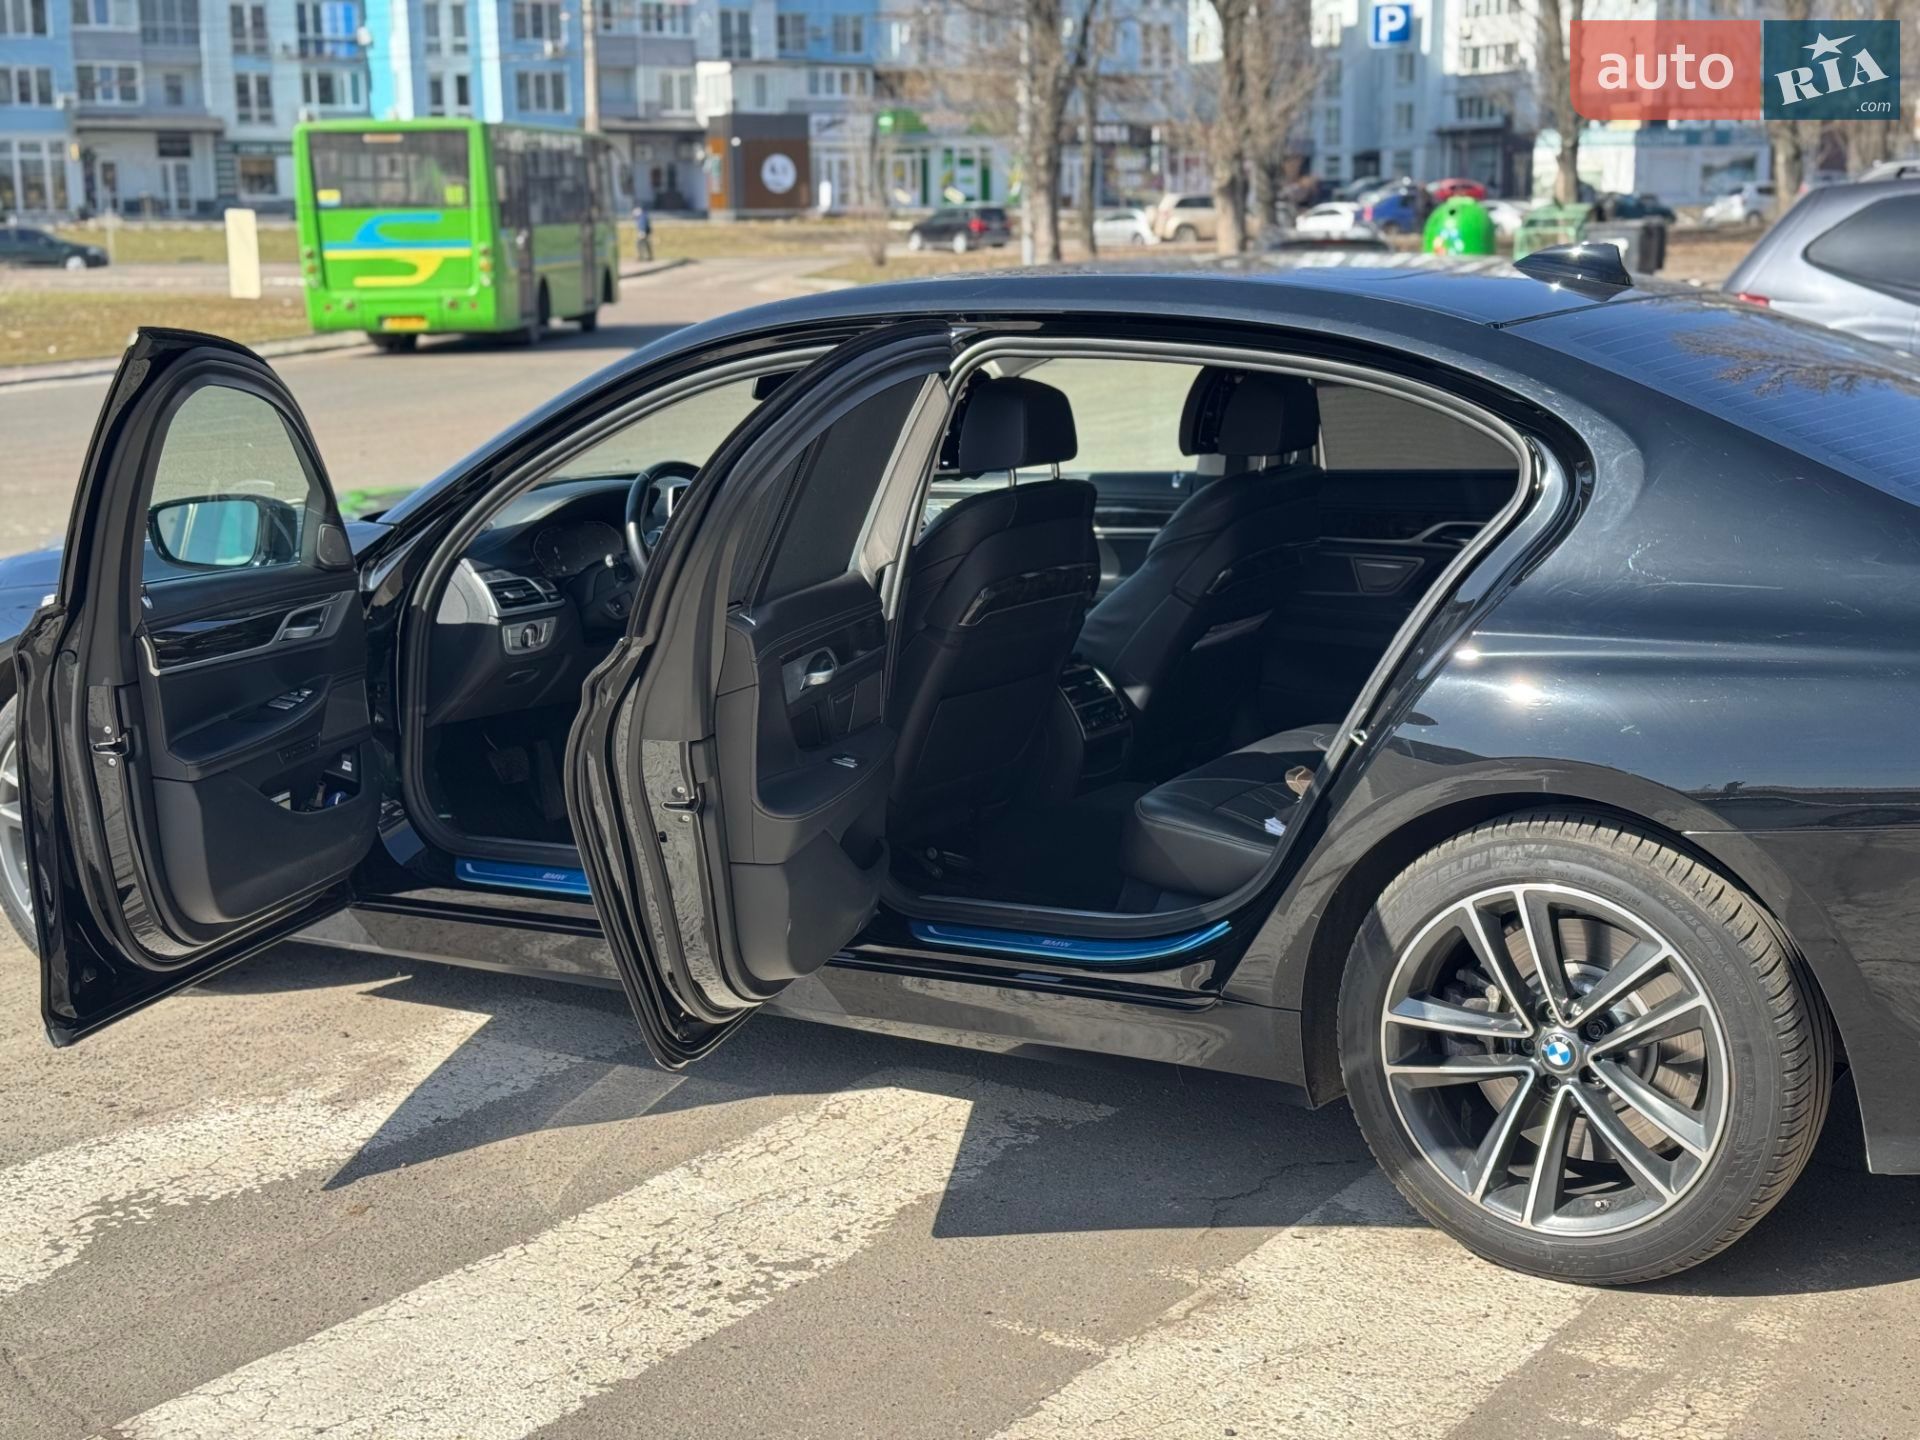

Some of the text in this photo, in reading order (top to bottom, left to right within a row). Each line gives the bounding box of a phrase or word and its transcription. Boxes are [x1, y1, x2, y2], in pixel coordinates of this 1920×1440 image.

[1379, 6, 1406, 41] P
[542, 871, 568, 881] BMW
[1042, 938, 1072, 948] BMW
[1541, 1034, 1570, 1050] BMW
